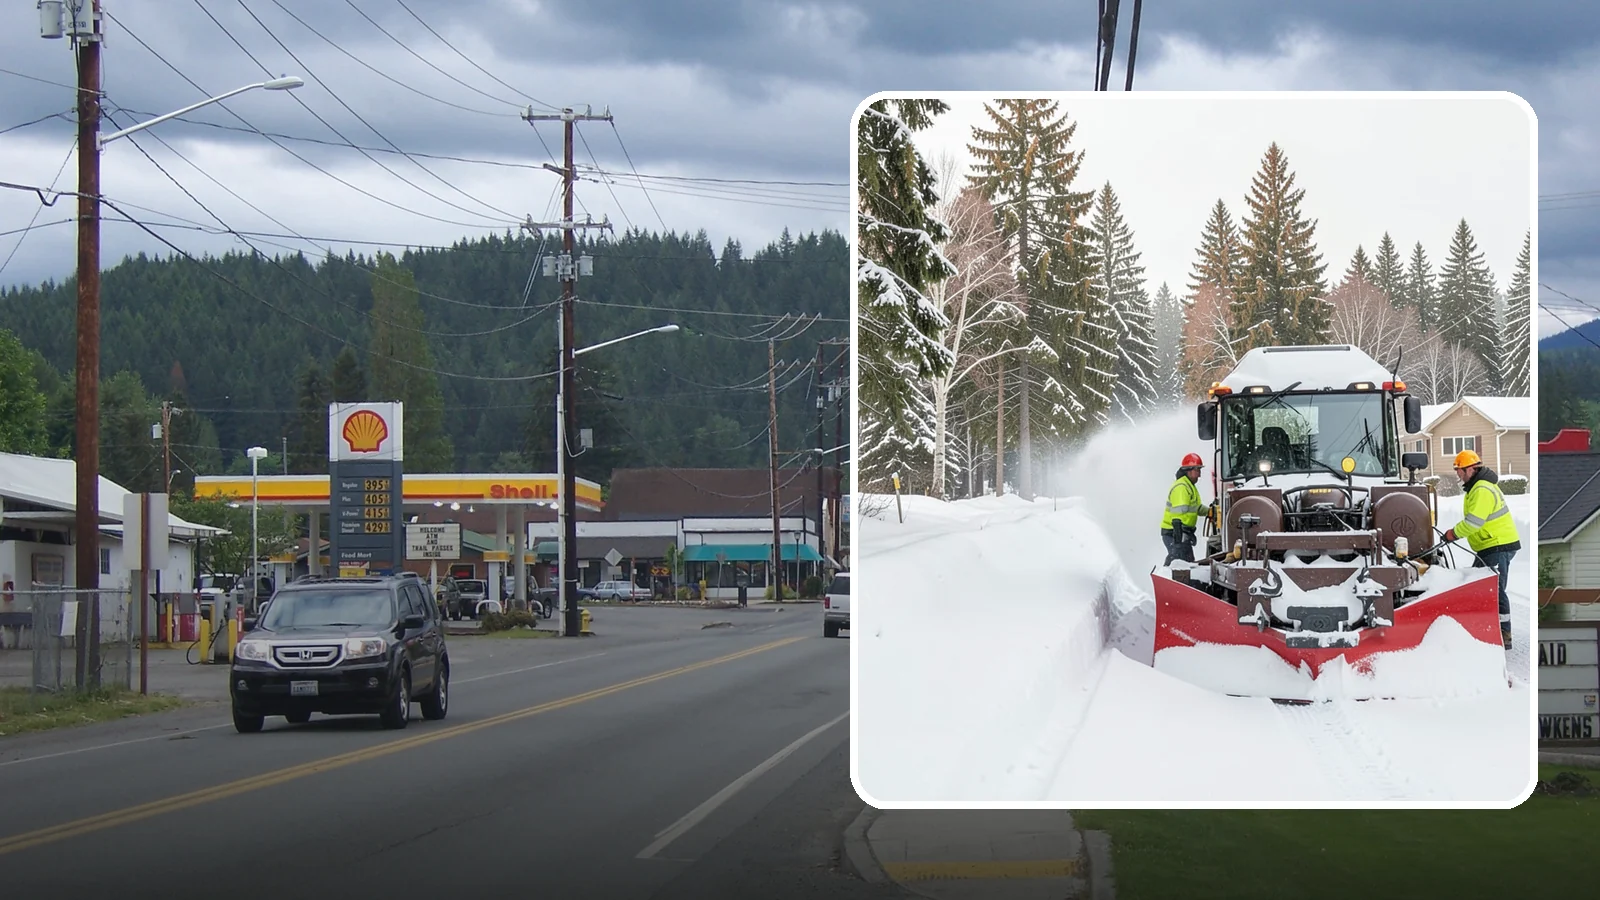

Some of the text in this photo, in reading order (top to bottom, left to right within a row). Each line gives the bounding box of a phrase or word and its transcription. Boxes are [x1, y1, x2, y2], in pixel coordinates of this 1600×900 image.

[366, 480, 383, 490] 395
[490, 484, 547, 499] Shell
[366, 494, 383, 504] 405
[366, 508, 383, 518] 415
[366, 522, 383, 532] 429
